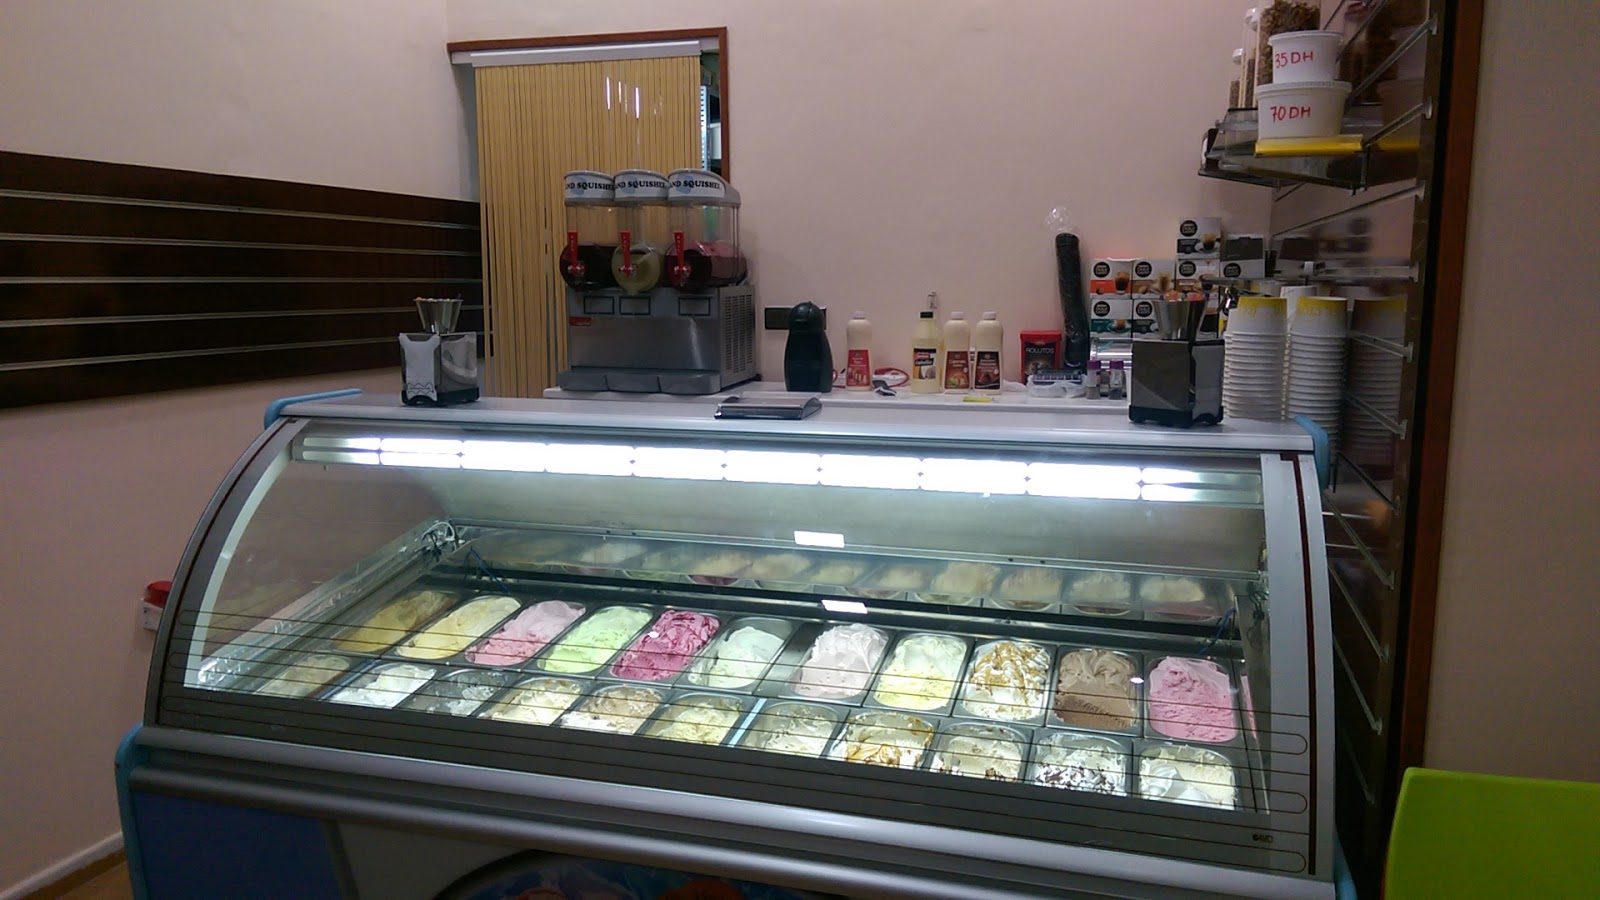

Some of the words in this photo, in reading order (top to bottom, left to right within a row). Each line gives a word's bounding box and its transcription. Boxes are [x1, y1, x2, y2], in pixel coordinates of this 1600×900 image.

[1275, 52, 1288, 68] 35
[1290, 51, 1314, 64] DH
[1270, 105, 1287, 122] 70
[1289, 106, 1311, 119] DH
